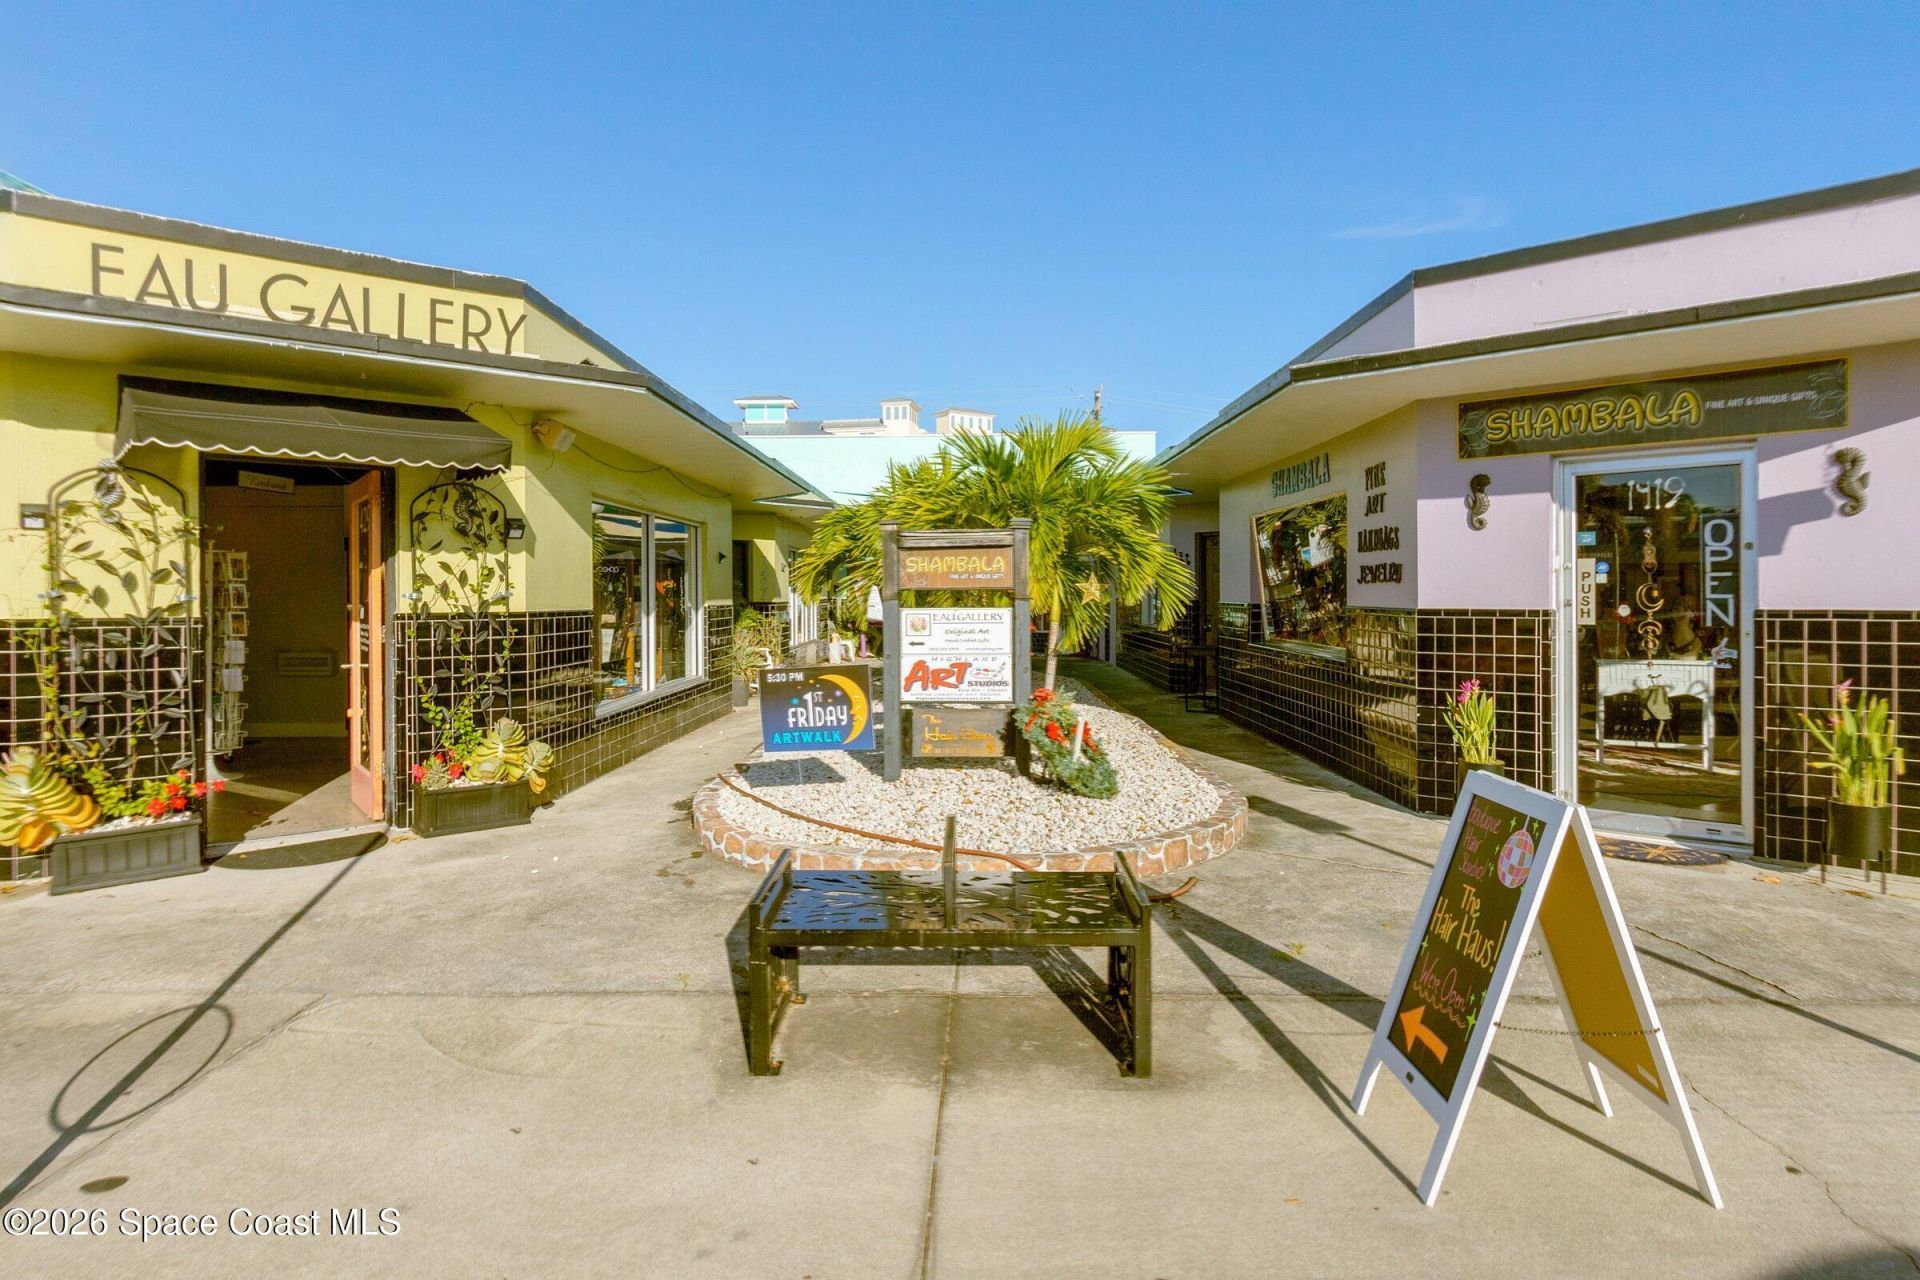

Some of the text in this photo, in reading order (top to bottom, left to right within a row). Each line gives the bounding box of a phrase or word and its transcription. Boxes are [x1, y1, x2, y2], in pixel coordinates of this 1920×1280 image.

[91, 243, 528, 355] EAU GALLERY
[1485, 390, 1700, 443] SHAMBALA
[1727, 397, 1744, 408] ART
[1272, 453, 1331, 499] SHAMBALA
[1364, 461, 1386, 491] FINE
[1364, 492, 1387, 517] ART
[1627, 476, 1686, 511] 1419
[1357, 526, 1400, 553] HANDBAGS
[905, 556, 1005, 573] SHAMBALA
[1357, 562, 1403, 584] JEWELRY
[1703, 519, 1735, 627] OPEN
[1580, 571, 1592, 618] PUSH
[945, 627, 976, 636] Original
[788, 671, 804, 681] PM
[903, 659, 973, 692] ART
[773, 730, 842, 744] ARTWALK
[1463, 826, 1482, 853] Hair
[1461, 884, 1481, 918] The
[1430, 896, 1507, 973] Hair Haus!
